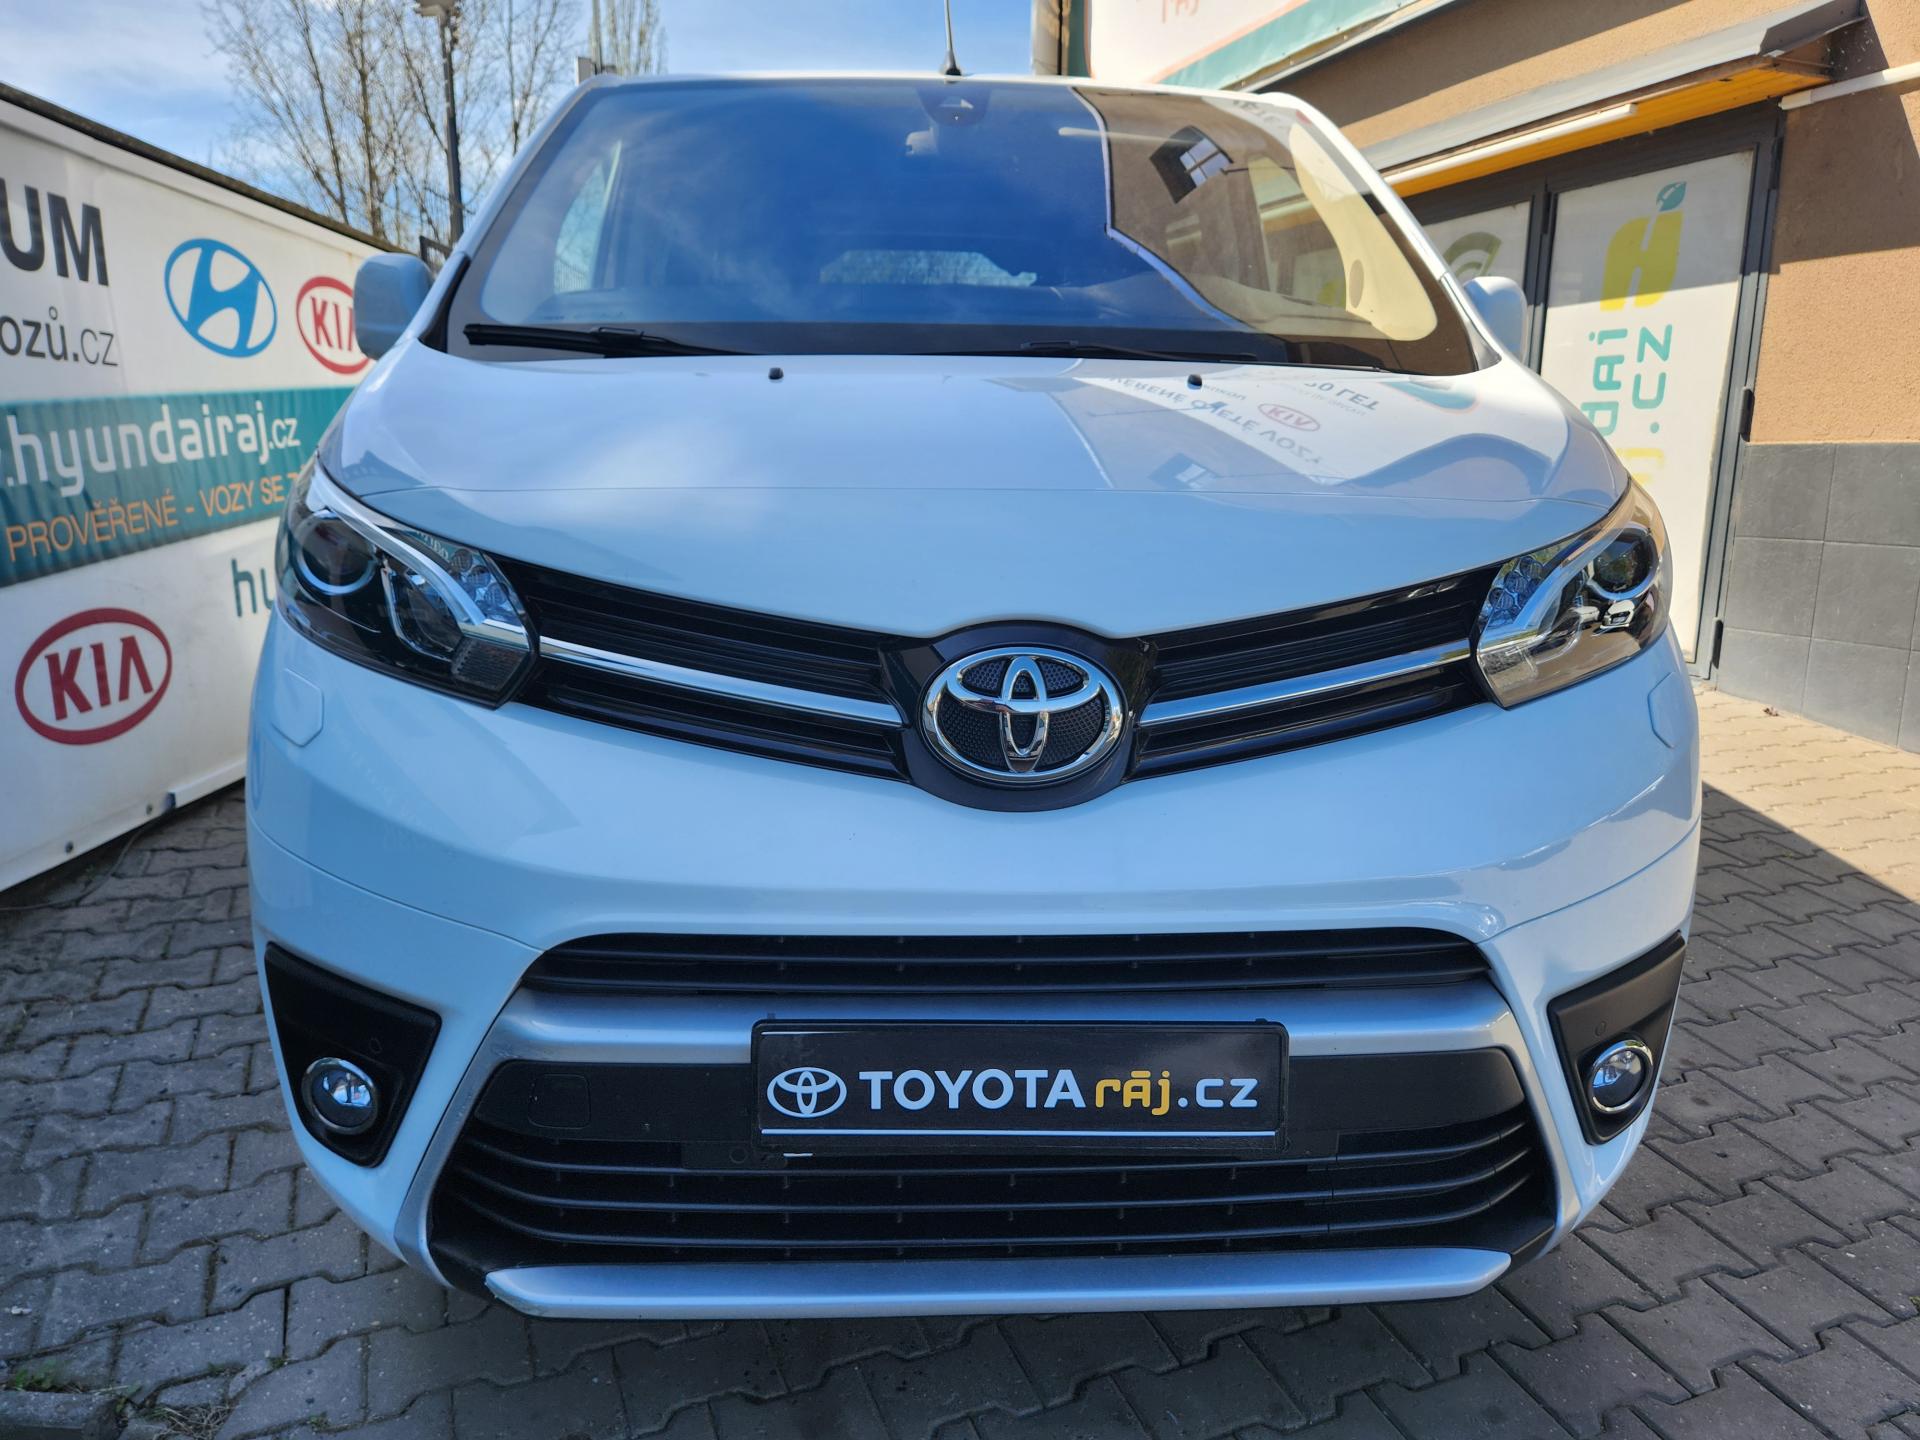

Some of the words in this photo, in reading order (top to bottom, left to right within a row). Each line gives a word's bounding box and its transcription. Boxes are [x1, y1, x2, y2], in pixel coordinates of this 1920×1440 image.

[0, 177, 109, 287] UM
[6, 488, 178, 562] PROVĚŘENÉ
[200, 480, 254, 517] VOZY
[260, 475, 285, 505] SE
[45, 635, 154, 721] KIA
